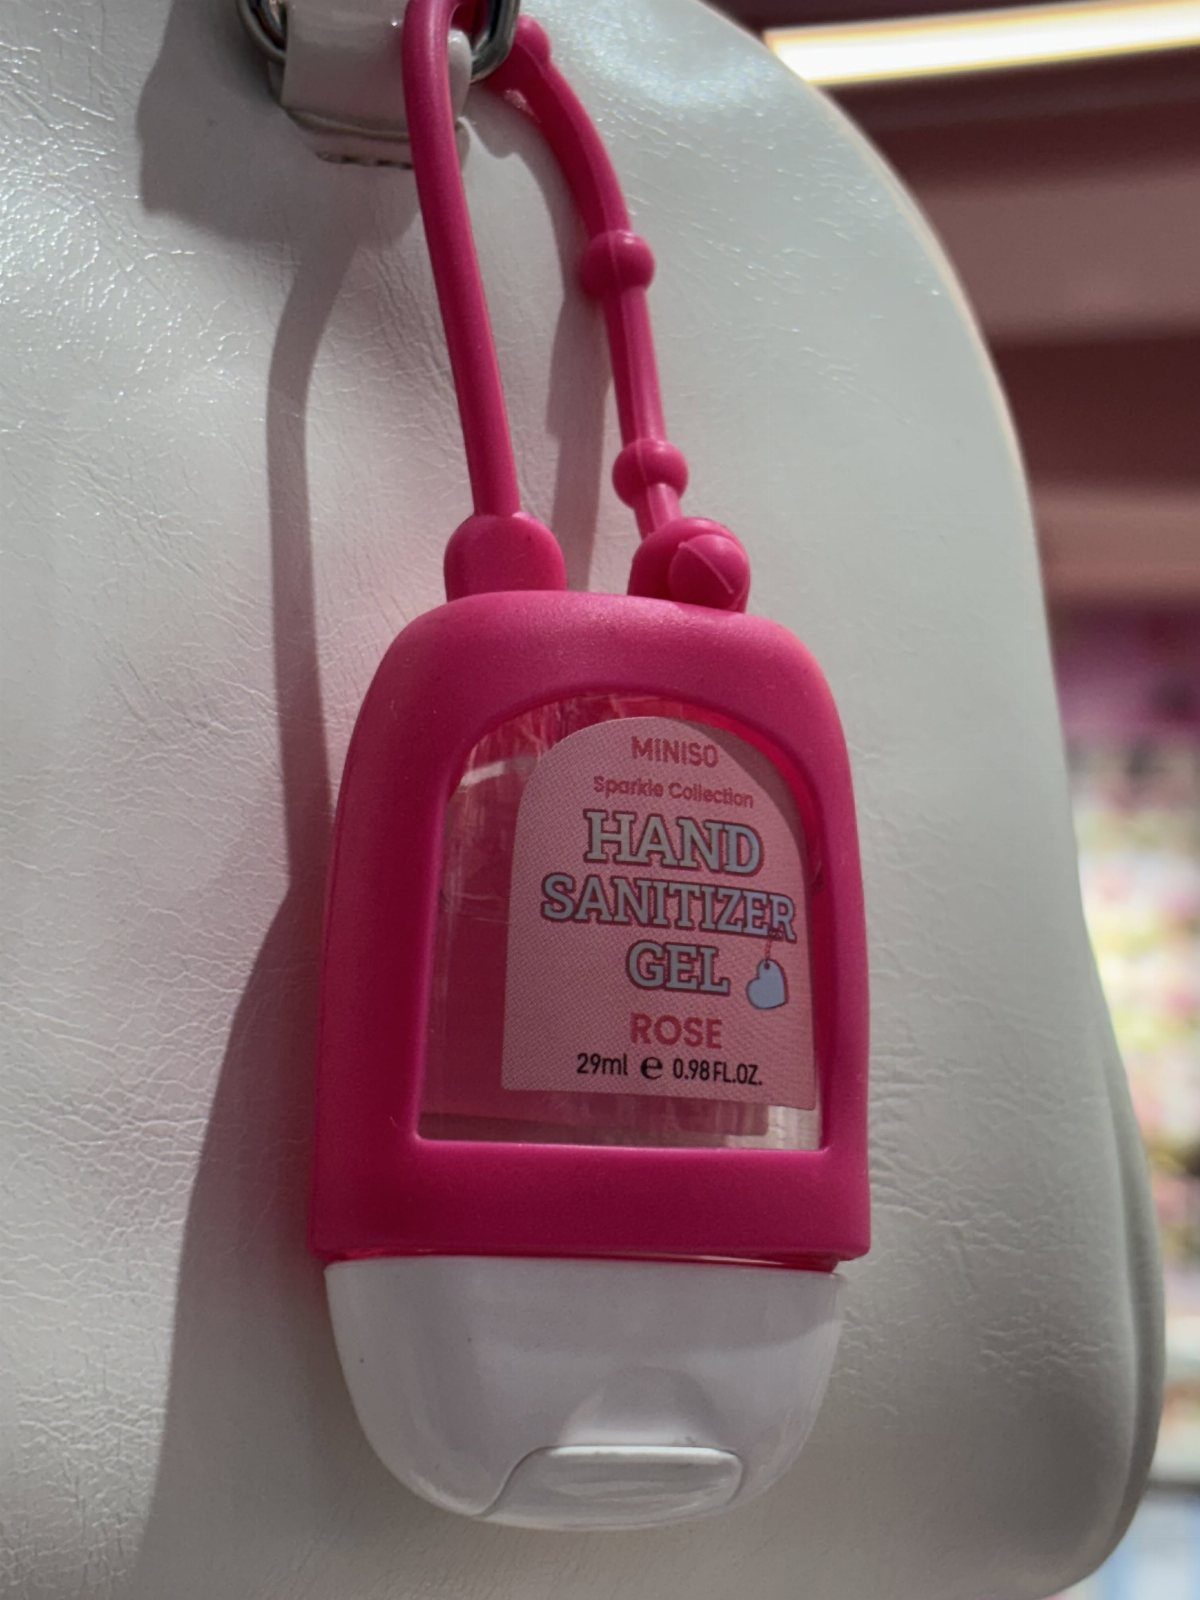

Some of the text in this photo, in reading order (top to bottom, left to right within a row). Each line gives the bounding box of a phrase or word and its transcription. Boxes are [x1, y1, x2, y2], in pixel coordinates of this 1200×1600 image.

[631, 736, 719, 769] MINISO
[593, 775, 754, 809] Sparkle Collection
[583, 808, 764, 877] HAND
[541, 872, 797, 944] SANITIZER
[626, 940, 731, 996] GEL
[629, 1012, 723, 1049] ROSE
[576, 1053, 628, 1077] 29ml
